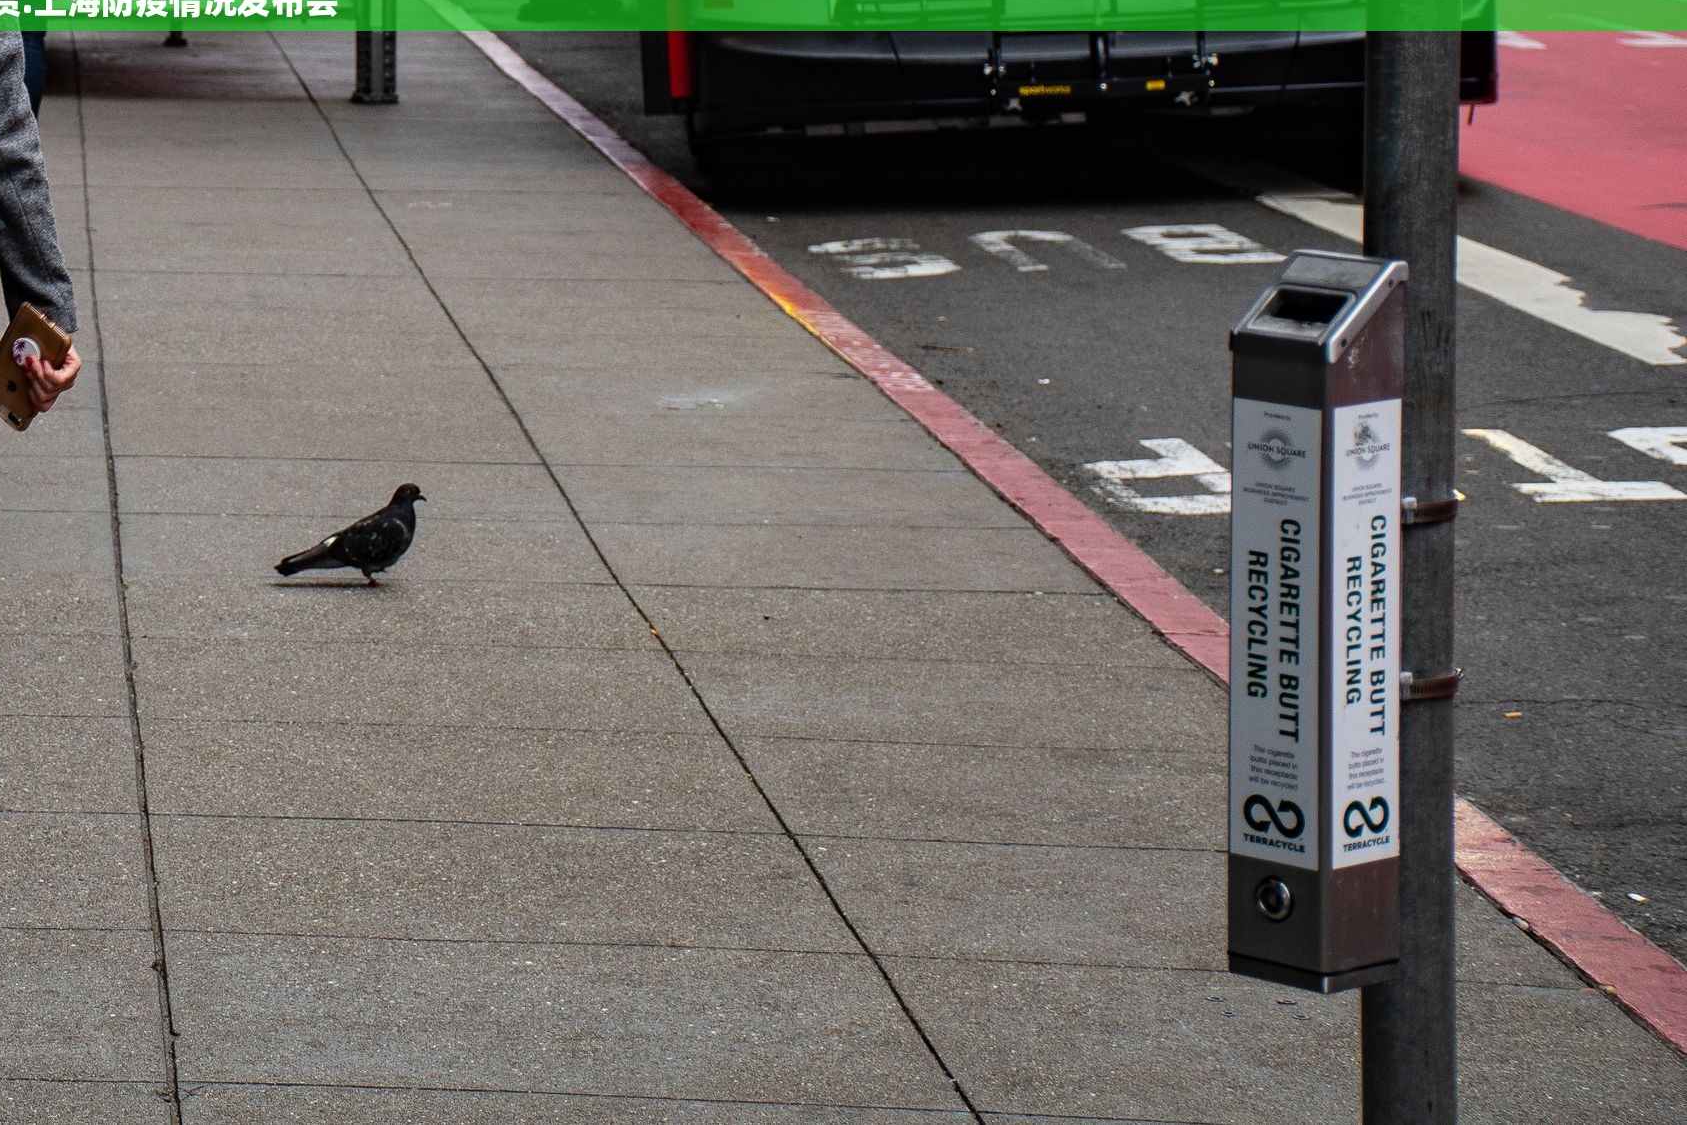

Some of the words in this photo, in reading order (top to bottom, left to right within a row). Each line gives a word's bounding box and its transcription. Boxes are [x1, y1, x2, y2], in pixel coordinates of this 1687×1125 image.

[1247, 441, 1274, 454] UNION
[1275, 445, 1306, 458] SQUARE
[1346, 445, 1366, 457] UNION
[1367, 442, 1391, 454] SQUARE
[1279, 518, 1301, 665] CIGARETTE
[1370, 515, 1386, 661] CIGARETTE
[1248, 550, 1269, 699] RECYCLING
[1346, 555, 1362, 705] RECYCLING
[1278, 673, 1300, 743] BUTT
[1370, 670, 1386, 736] BUTT
[1254, 744, 1266, 754] The
[1350, 750, 1361, 759] The
[1269, 757, 1292, 770] placed
[1362, 759, 1377, 769] placed
[1243, 833, 1306, 854] TERRACYCLE
[1343, 836, 1391, 852] TERRACYCLE
